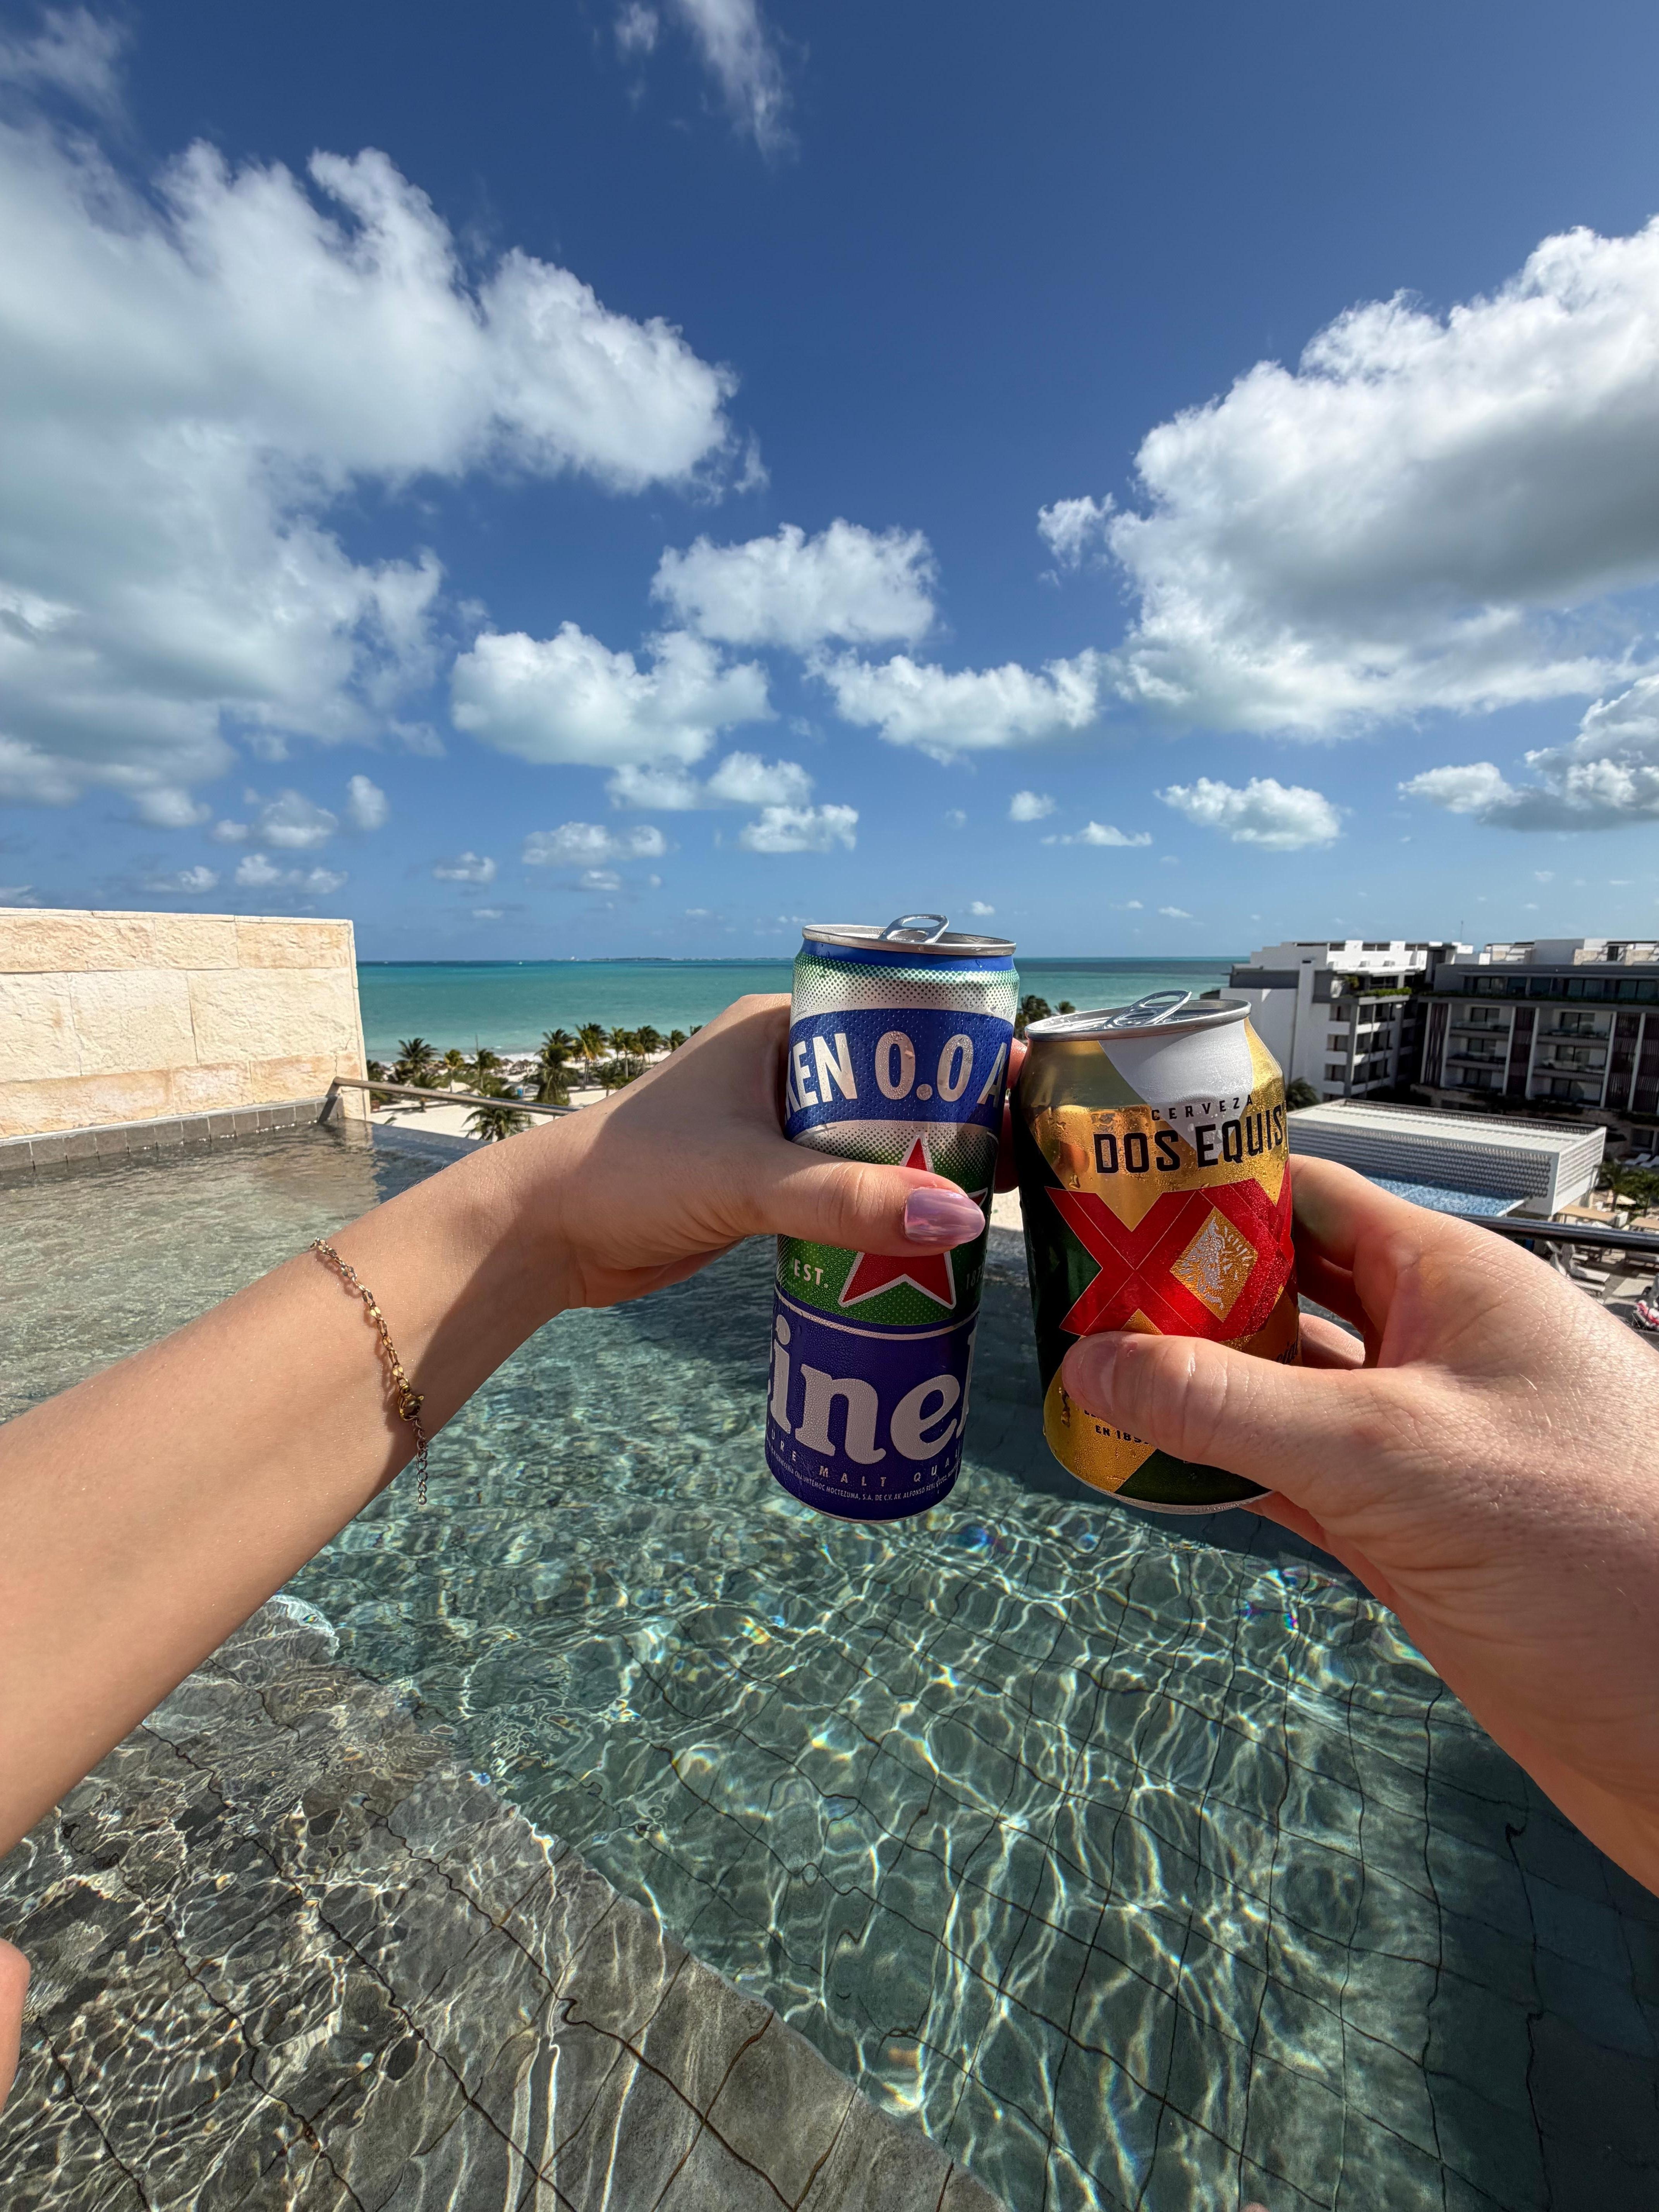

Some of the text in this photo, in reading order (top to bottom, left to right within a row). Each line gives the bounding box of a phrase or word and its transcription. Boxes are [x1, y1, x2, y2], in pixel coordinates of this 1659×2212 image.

[875, 1030, 974, 1103] 0.0
[1151, 1094, 1253, 1121] CERVEZA
[1093, 1104, 1283, 1174] DOS EQUIS
[794, 1259, 829, 1289] EST.
[768, 1314, 977, 1465] ine
[768, 1420, 797, 1462] URE
[819, 1465, 886, 1487] MALT
[1095, 1425, 1149, 1444] EN 18
[903, 1486, 925, 1499] ALFONSO
